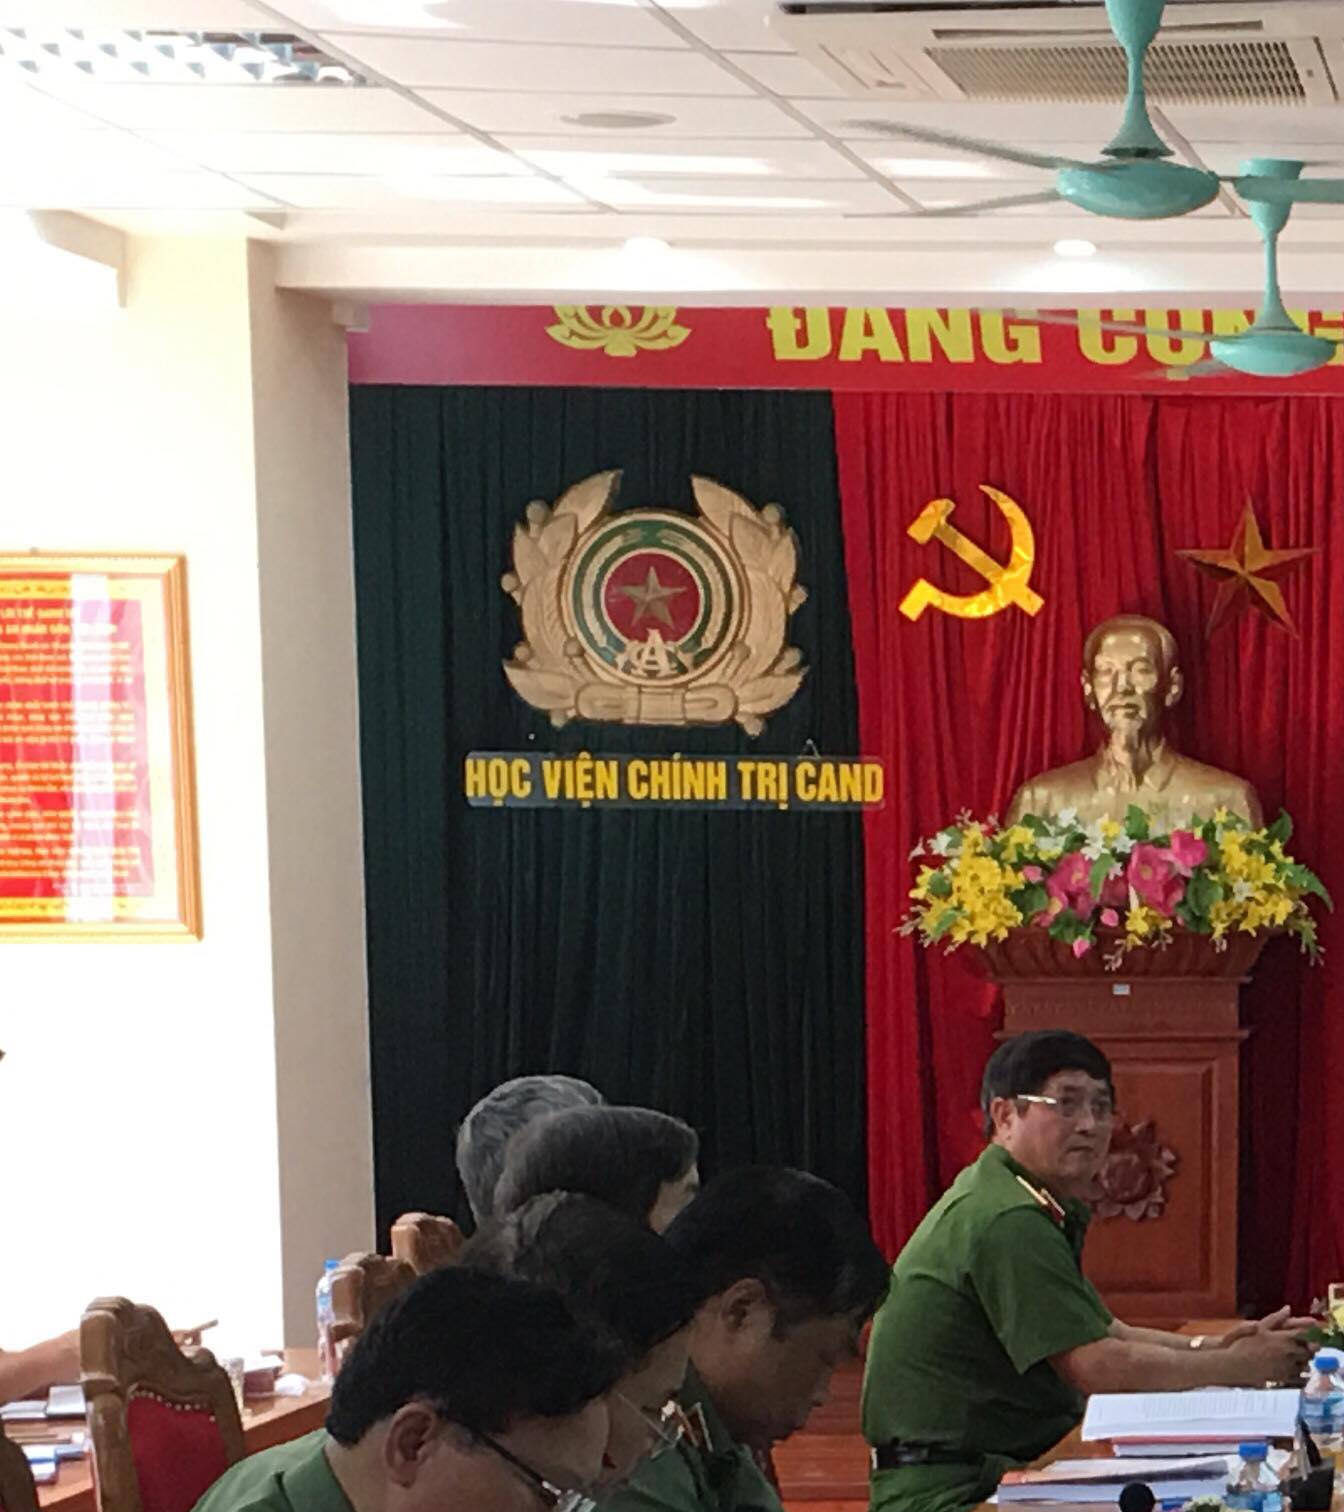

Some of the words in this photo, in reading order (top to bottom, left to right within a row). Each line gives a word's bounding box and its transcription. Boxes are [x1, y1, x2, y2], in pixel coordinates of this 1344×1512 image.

[464, 757, 533, 807] HỌC
[541, 751, 619, 808] VIỆN
[626, 752, 727, 801] CHÍNH
[736, 761, 790, 811] TRỊ
[795, 761, 884, 803] CAND
